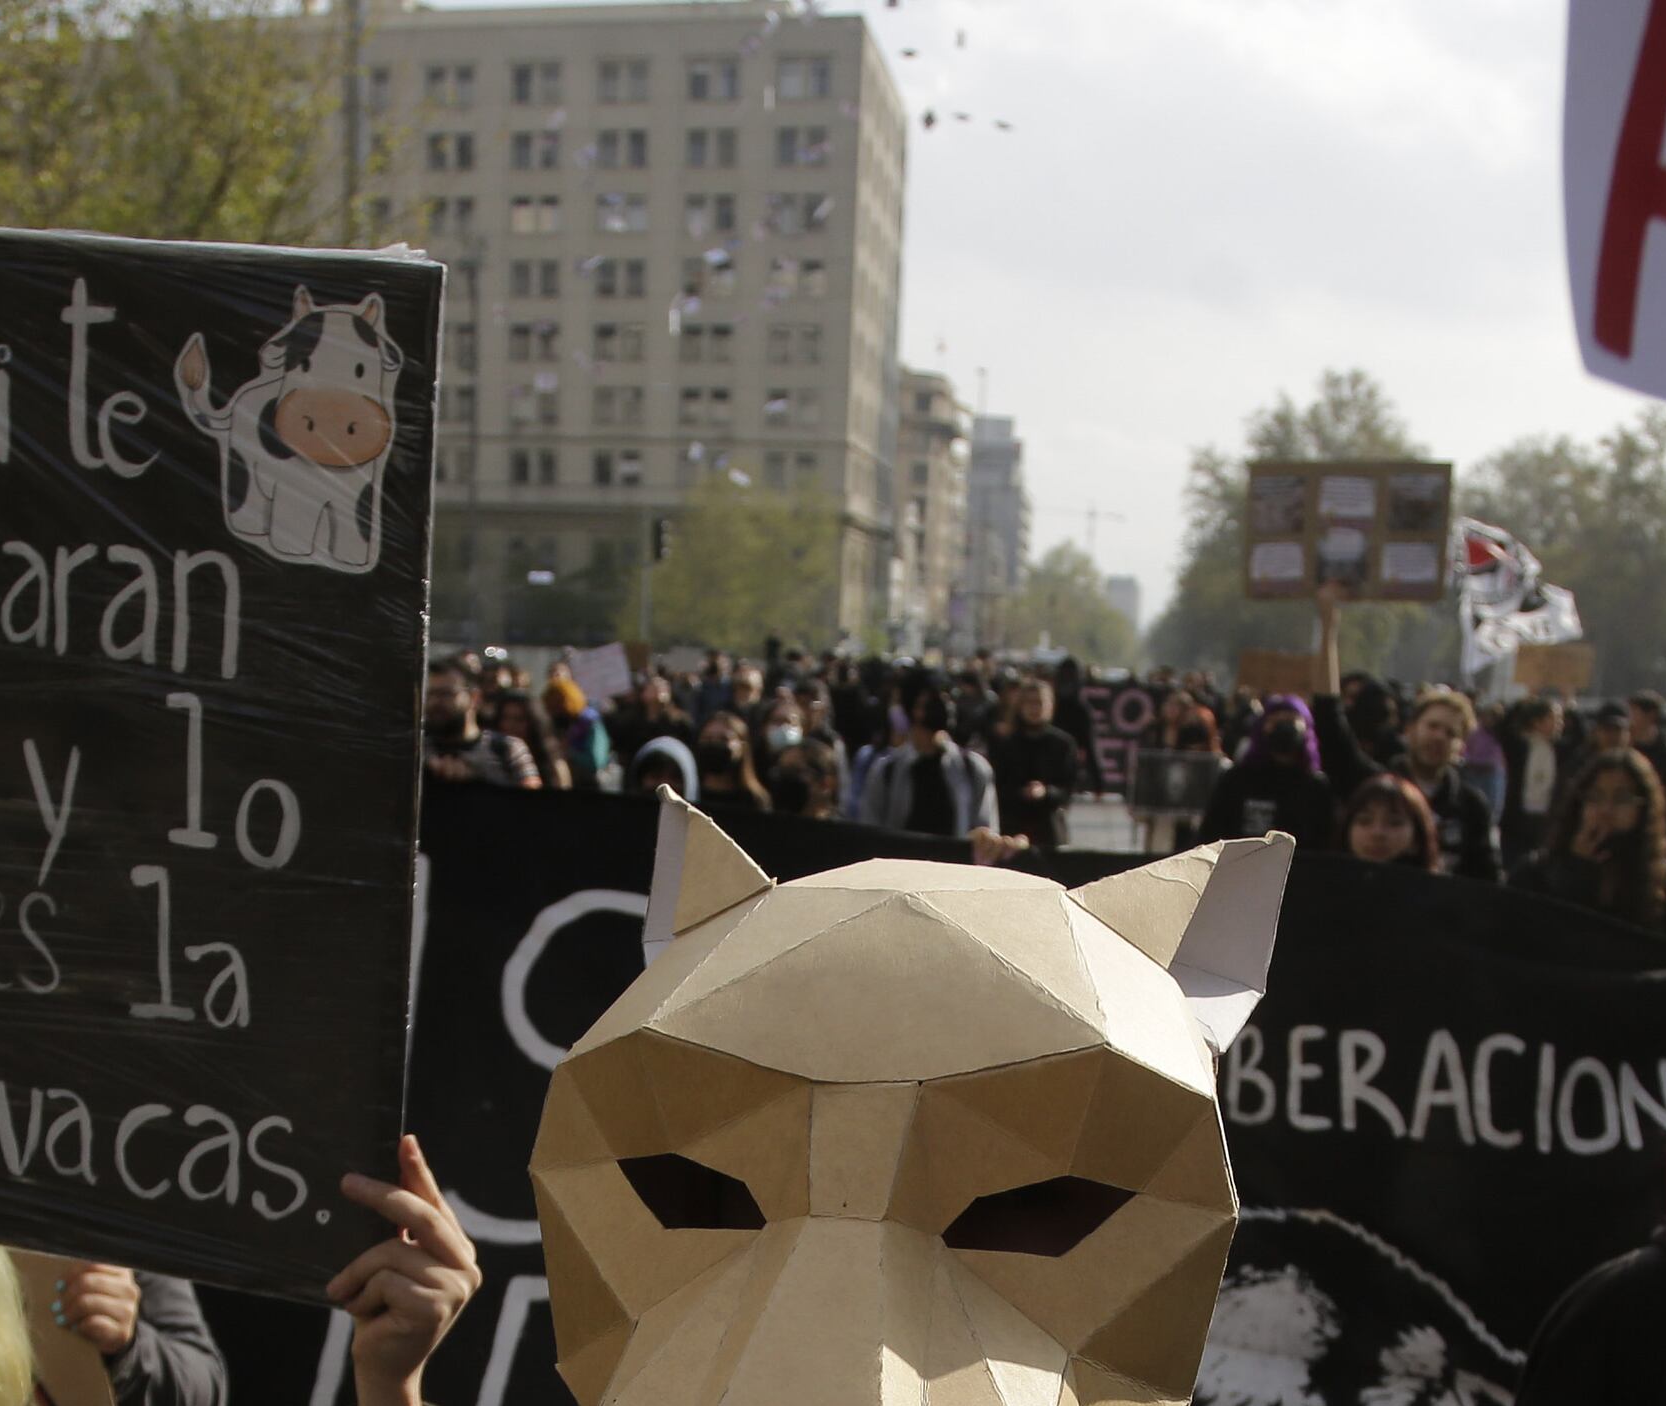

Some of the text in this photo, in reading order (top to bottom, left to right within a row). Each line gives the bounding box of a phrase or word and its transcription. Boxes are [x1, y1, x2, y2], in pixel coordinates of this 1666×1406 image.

[60, 277, 161, 478] te
[22, 739, 82, 887] y
[165, 691, 303, 870] lo
[130, 865, 251, 1029] la
